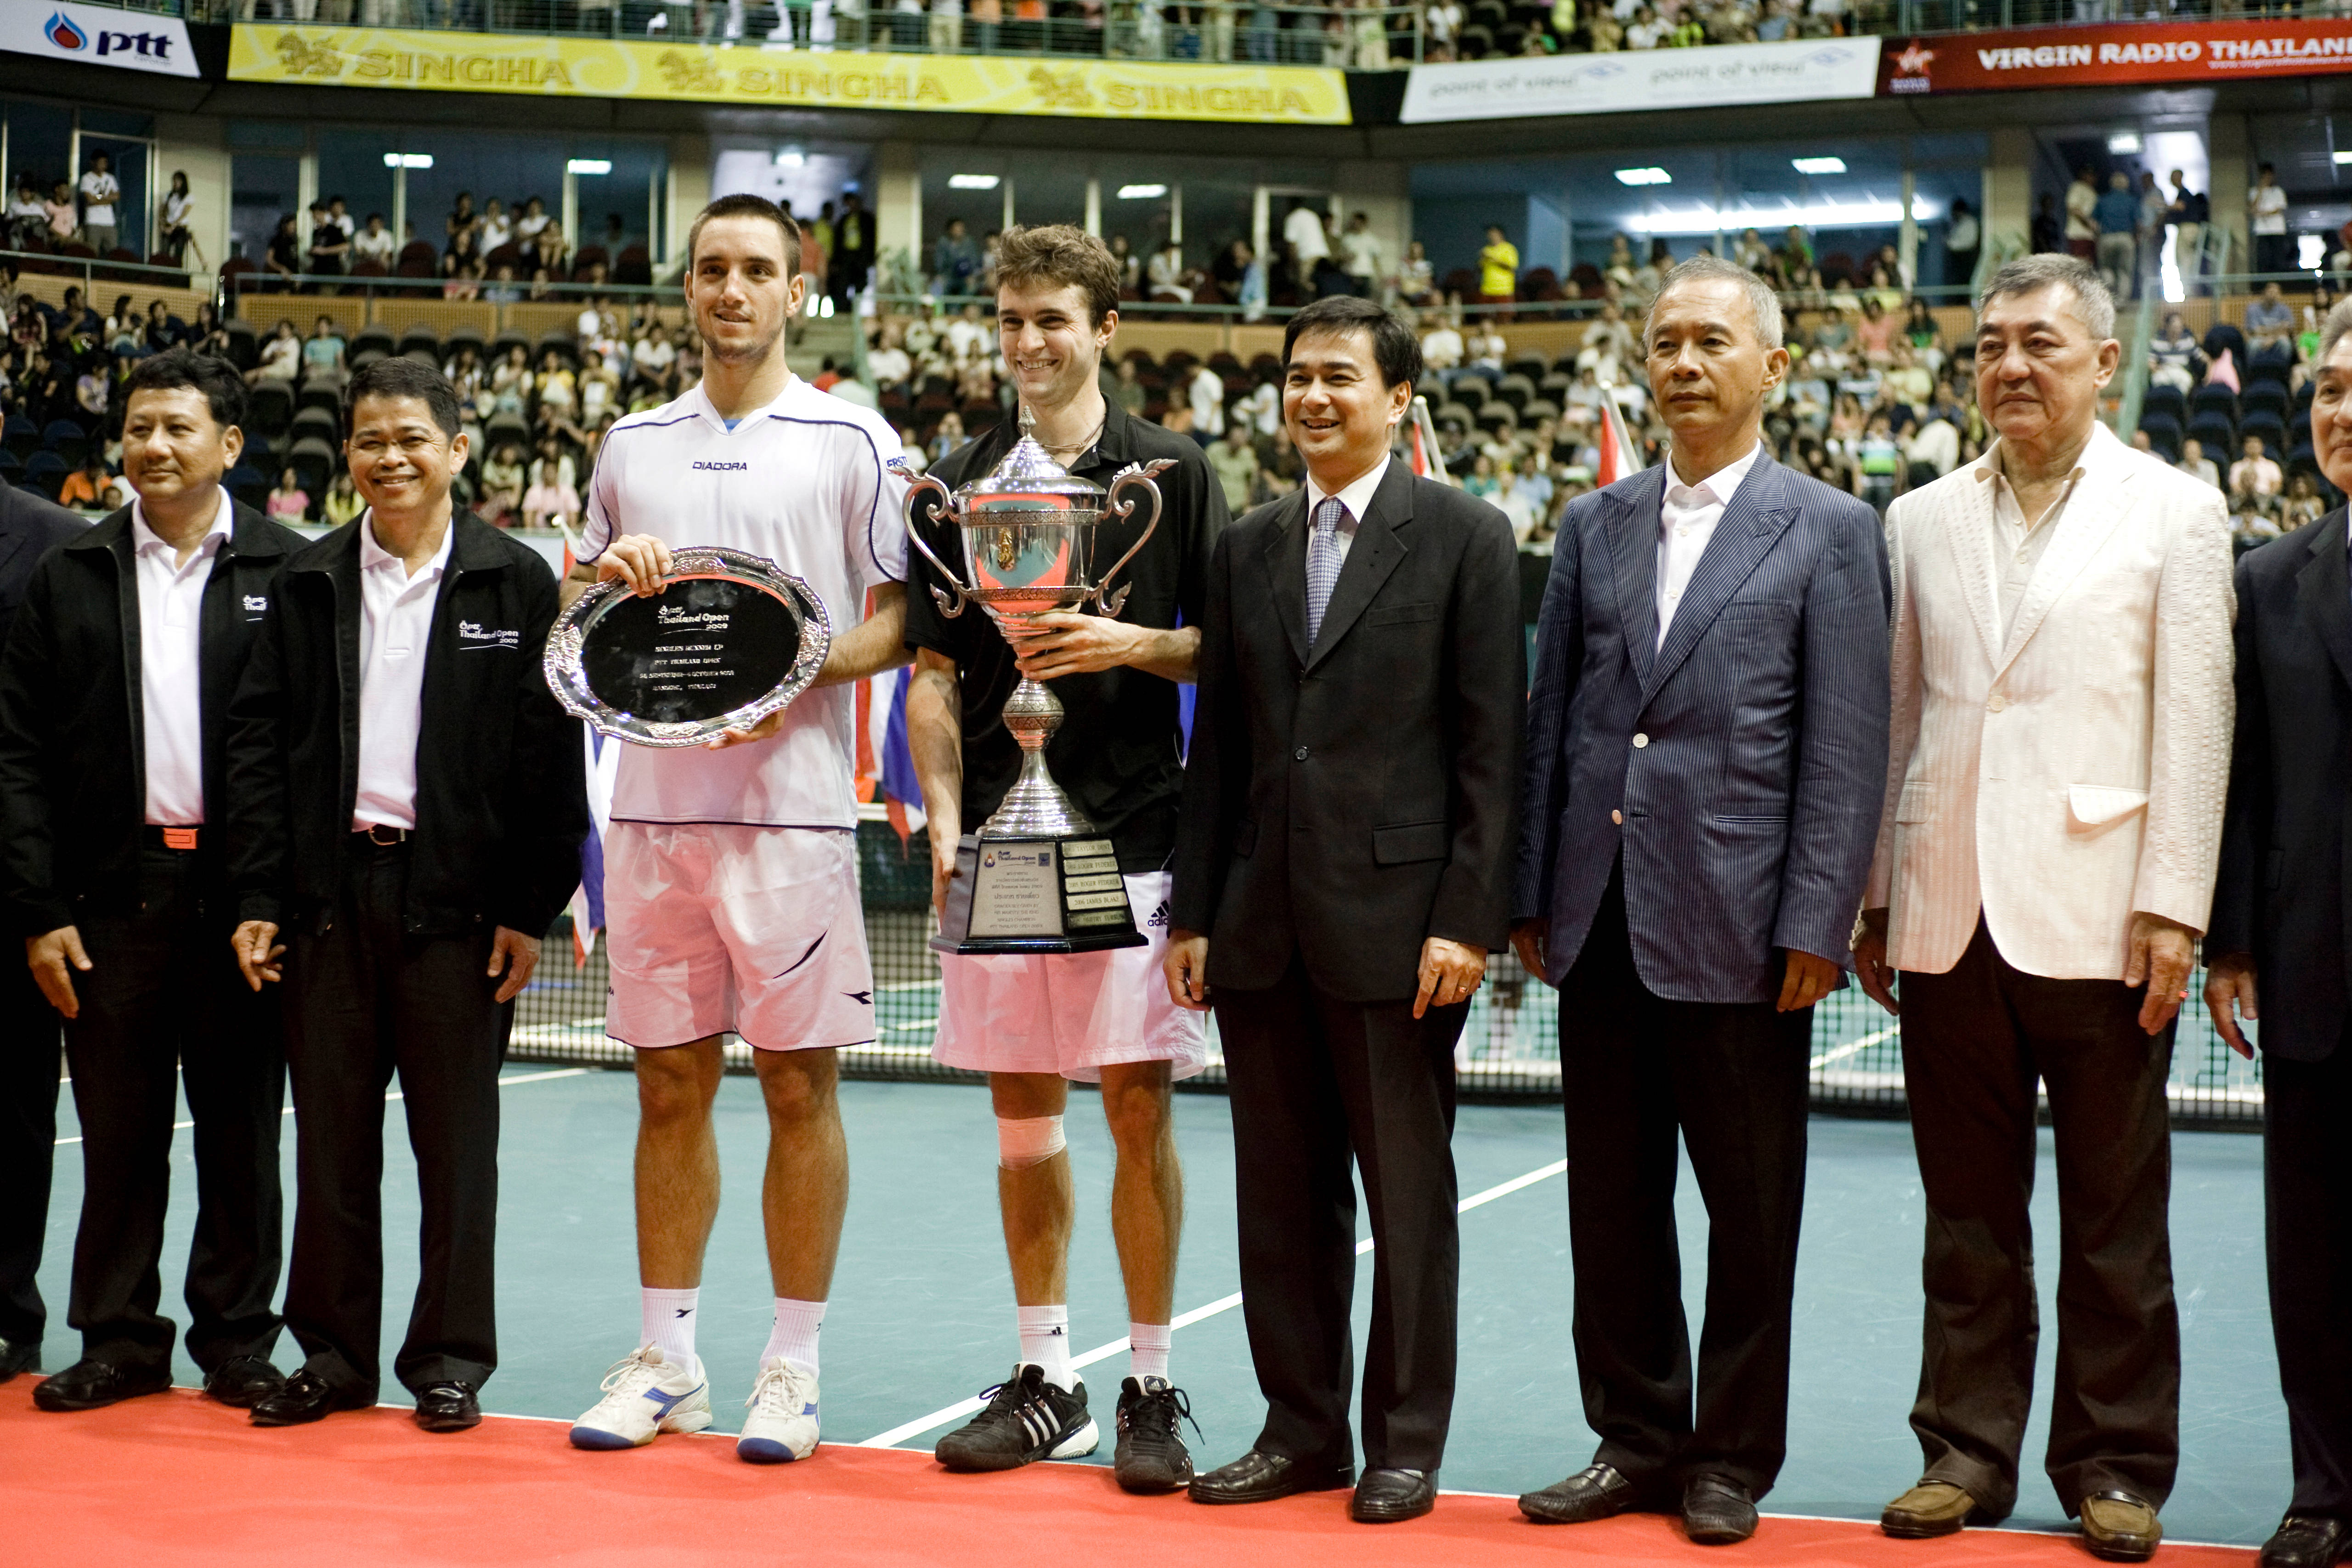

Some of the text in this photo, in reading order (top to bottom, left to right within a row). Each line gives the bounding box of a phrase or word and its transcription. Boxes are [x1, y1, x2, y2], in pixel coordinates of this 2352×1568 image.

[97, 30, 173, 59] ptt
[1977, 37, 2352, 71] VIRGIN RADIO THAILAN
[356, 49, 575, 86] SINGHA
[1717, 59, 1744, 79] of
[1747, 60, 1805, 75] view
[736, 67, 949, 102] SINGHA
[1494, 74, 1520, 90] of
[1523, 75, 1576, 89] view
[1107, 83, 1314, 114] SINGHA
[692, 461, 747, 470] DIADORA
[243, 602, 267, 611] Thail
[657, 611, 730, 624] Thailand Open
[459, 628, 519, 640] Thailand Open
[1148, 916, 1168, 927] adi
